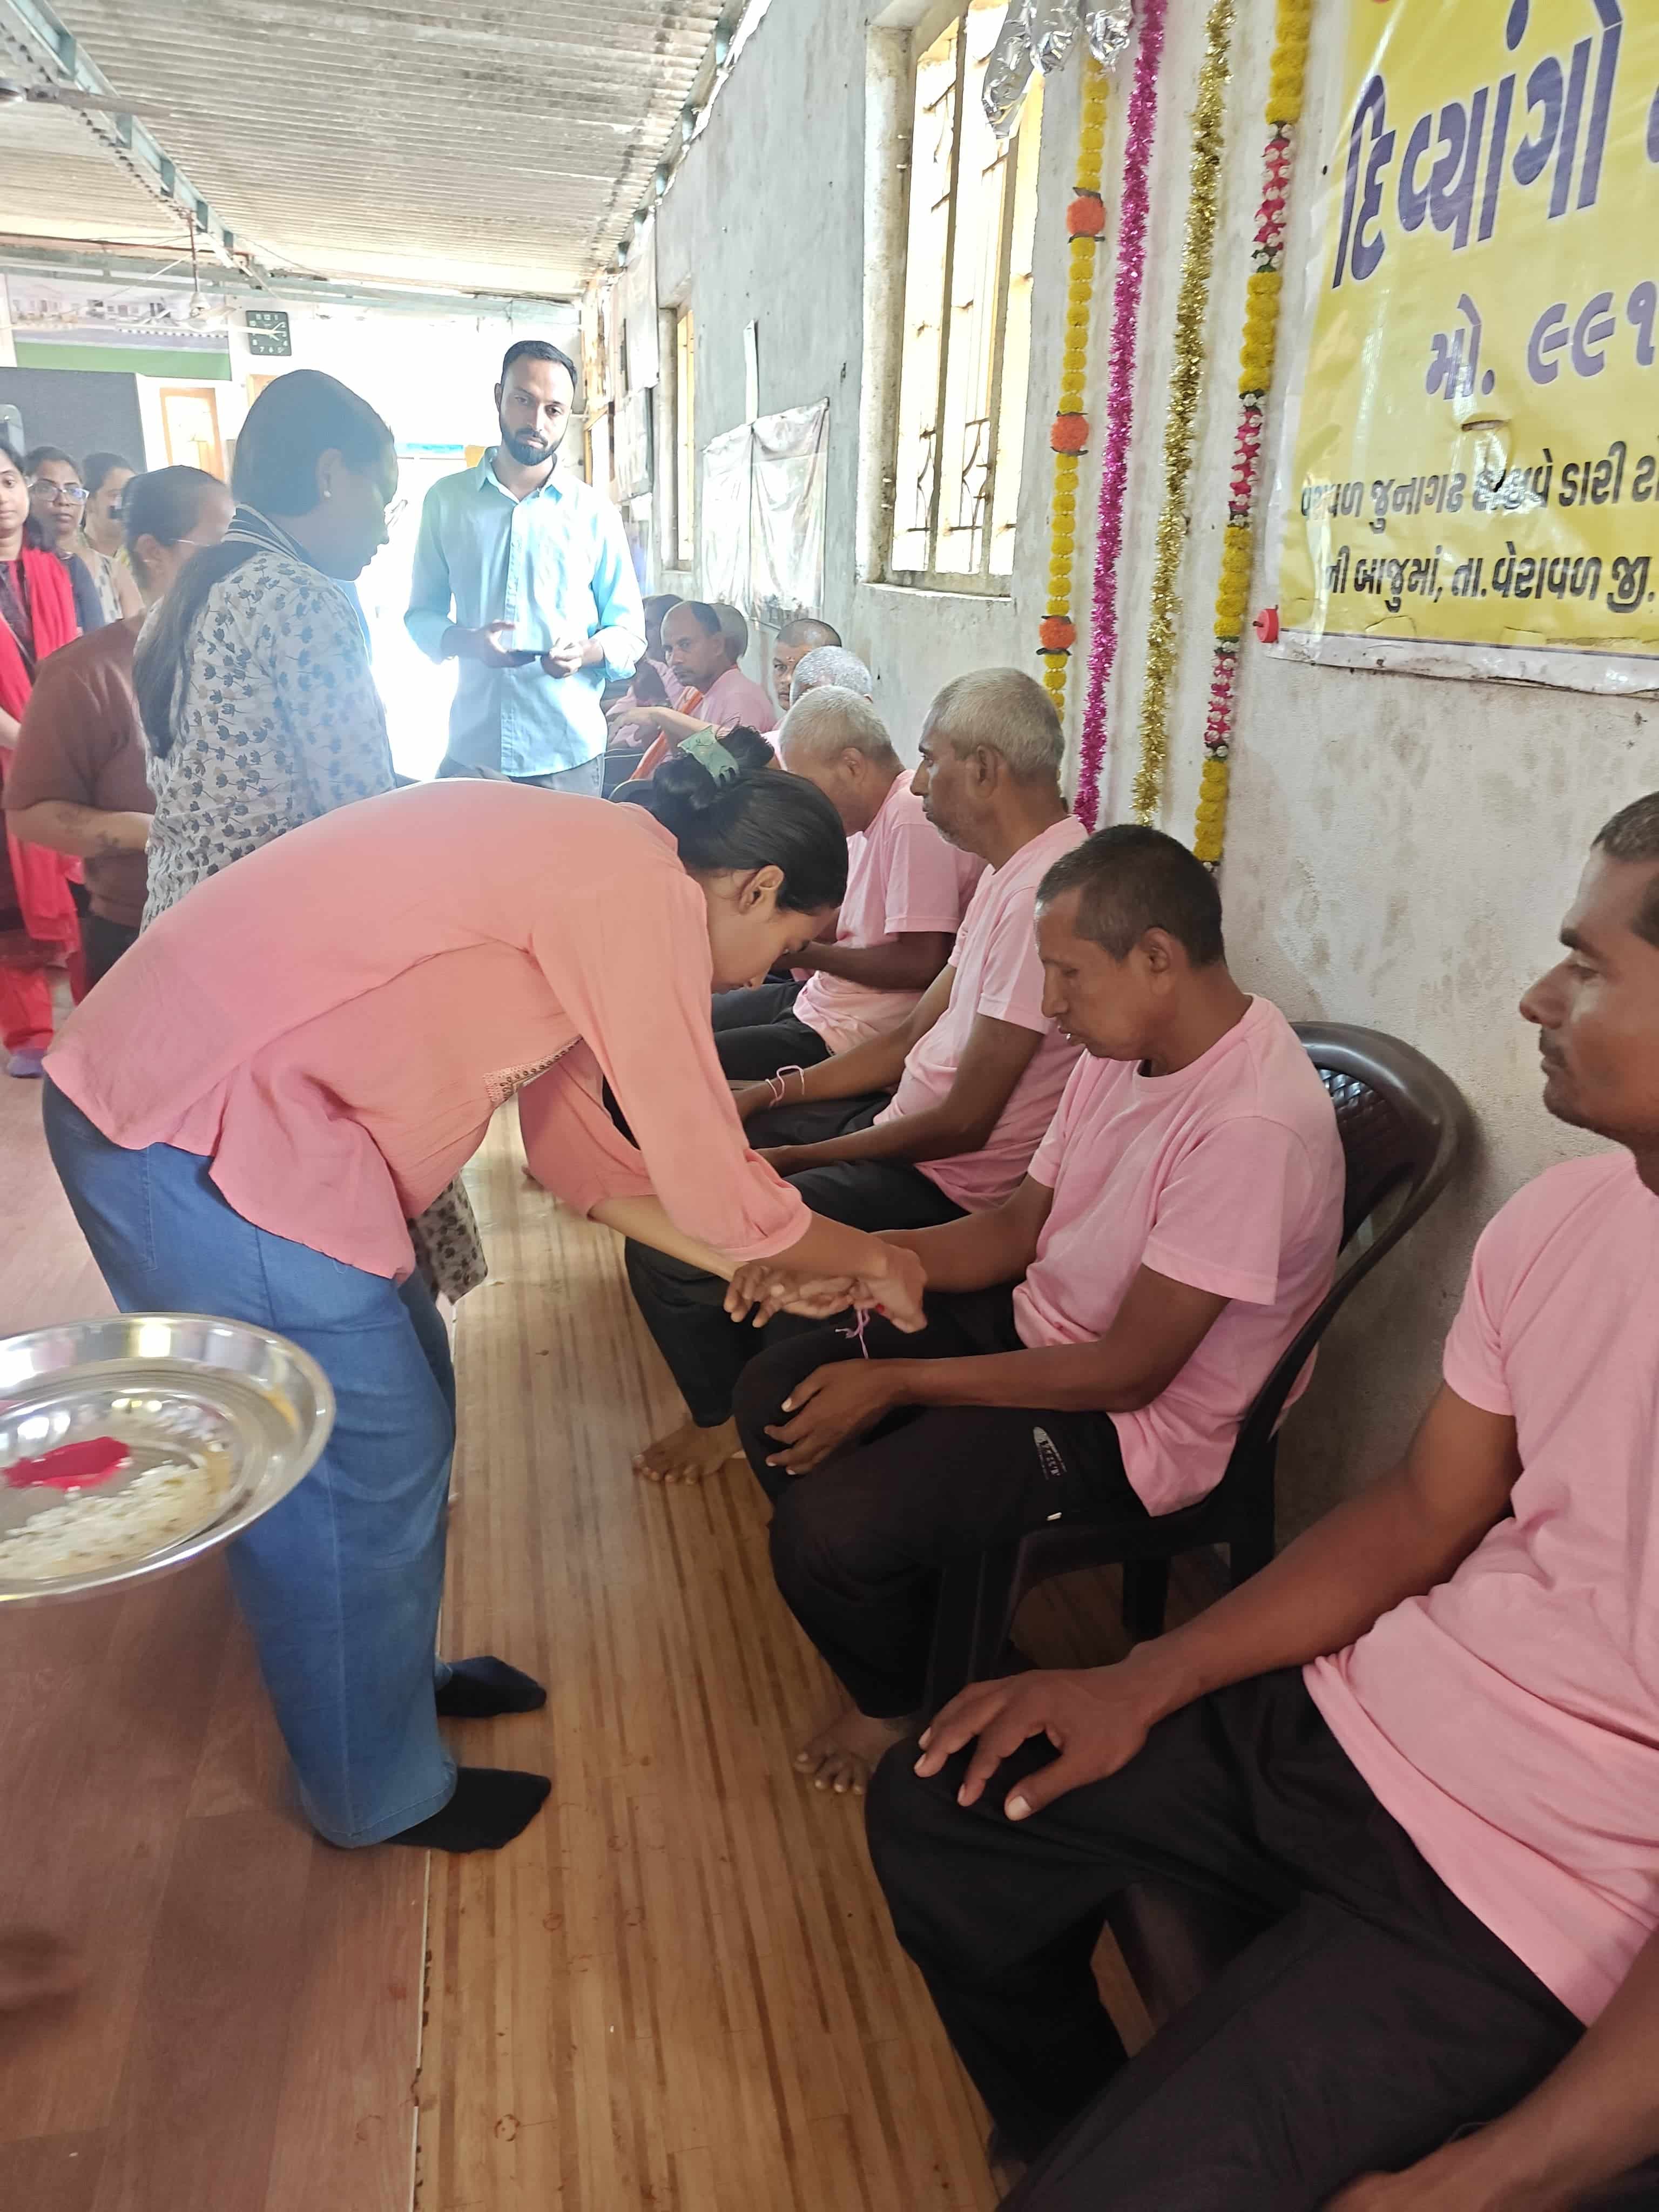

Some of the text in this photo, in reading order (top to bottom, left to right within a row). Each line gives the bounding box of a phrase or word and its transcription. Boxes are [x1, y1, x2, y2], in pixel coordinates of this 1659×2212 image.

[1425, 293, 1496, 400] મો.
[1368, 473, 1466, 535] જુનાગઢ
[1559, 440, 1627, 507] ડારી
